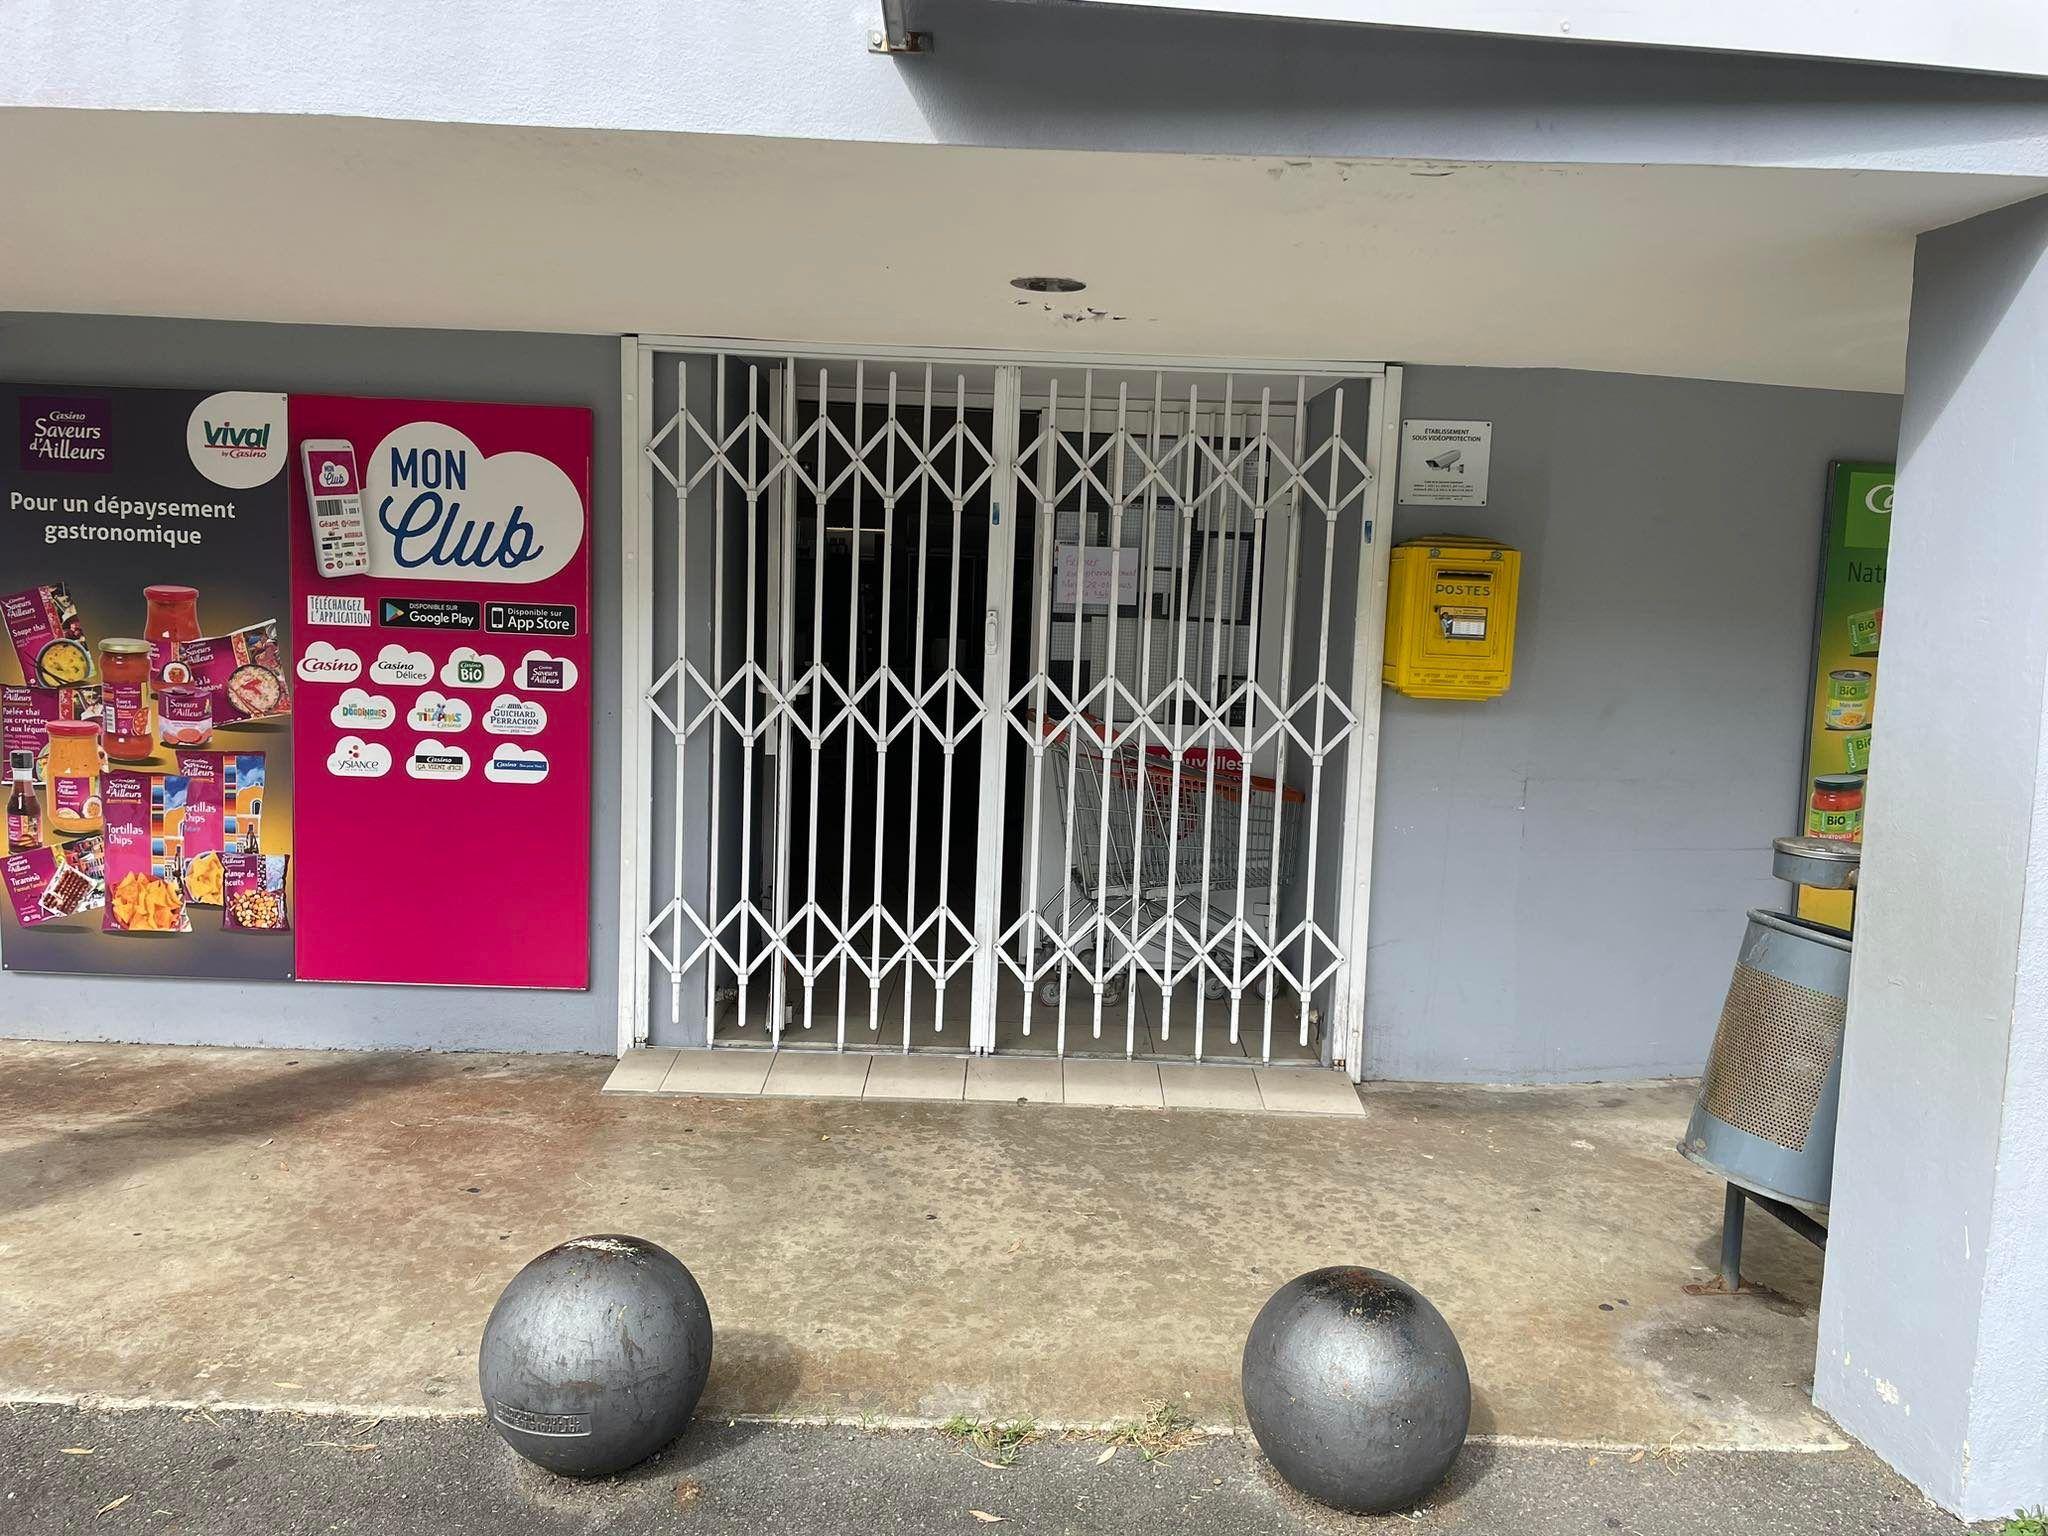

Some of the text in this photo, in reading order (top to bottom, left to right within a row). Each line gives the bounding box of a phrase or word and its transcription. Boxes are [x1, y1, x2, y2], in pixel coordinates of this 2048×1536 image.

[50, 410, 86, 421] Casino
[34, 418, 101, 439] Saveurs
[203, 421, 271, 449] Vival
[29, 437, 105, 461] d'Ailleurs
[221, 449, 268, 459] by Casino
[391, 447, 466, 490] MON
[10, 491, 236, 520] Pour un dépaysement
[44, 523, 202, 548] gastronomique
[378, 491, 545, 569] Club
[1435, 584, 1491, 597] POSTES
[310, 596, 361, 612] TÉLÉCHARGEZ
[409, 603, 445, 611] DISPONIBLE
[310, 611, 370, 624] L'APPLICATION
[507, 608, 549, 617] Disponible
[409, 611, 474, 627] Google Play
[507, 617, 570, 631] App Store
[302, 658, 359, 672] Casino
[378, 660, 415, 671] Casino
[396, 671, 428, 680] Délices
[532, 668, 559, 677] Saveurs
[170, 699, 199, 708] Saveurs
[493, 708, 536, 718] GUICHARD
[490, 716, 539, 726] PERRACHON
[183, 760, 213, 770] Saveurs
[109, 780, 141, 790] Saveurs
[106, 788, 142, 798] d'Ailleurs
[185, 801, 217, 813] ortillas
[106, 823, 144, 835] Tortillas
[108, 834, 133, 847] Chips
[246, 869, 255, 877] de
